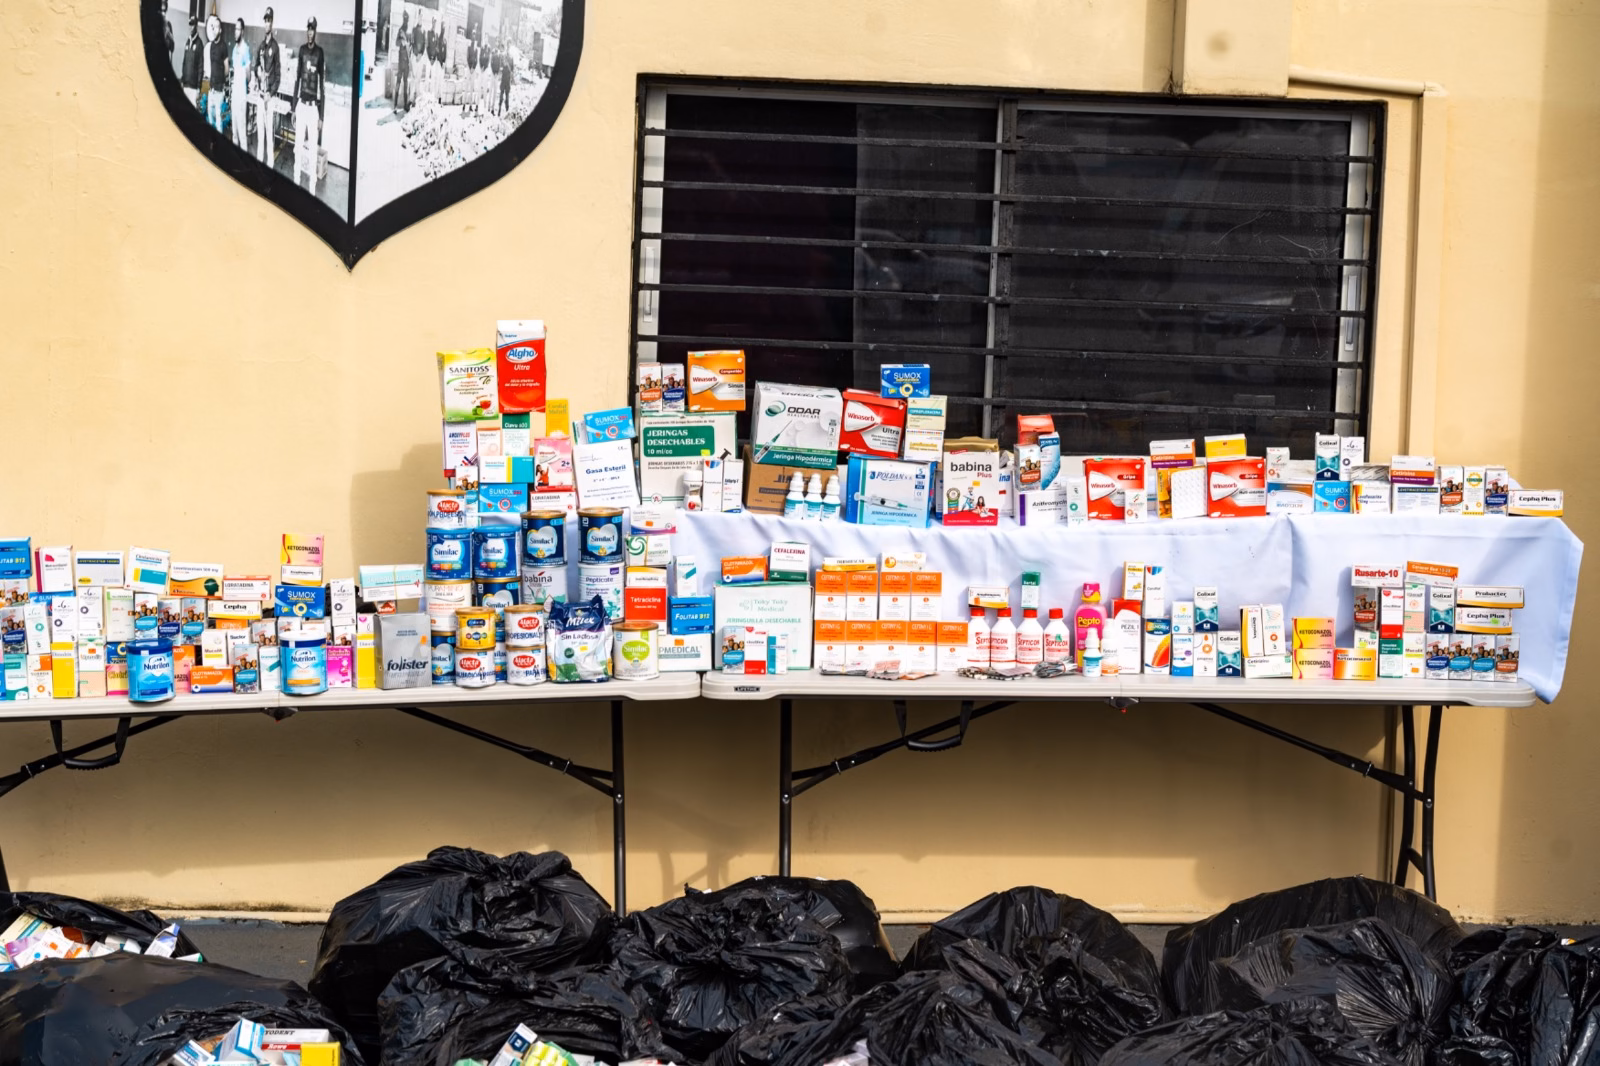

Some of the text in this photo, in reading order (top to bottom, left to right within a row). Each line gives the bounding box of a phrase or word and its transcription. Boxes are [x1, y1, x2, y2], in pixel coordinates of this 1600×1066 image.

[508, 349, 535, 359] Algho
[788, 407, 821, 415] ODAR
[595, 415, 619, 424] SUMOX
[848, 413, 874, 421] Winasorb
[882, 427, 900, 435] Ultra
[647, 438, 706, 446] DESECHABLES
[773, 453, 833, 463] Jeringa Hipodérmica
[951, 462, 992, 471] babina
[434, 548, 458, 556] Similac
[483, 546, 502, 554] Similac
[1355, 569, 1398, 577] Rusarte-10
[524, 574, 552, 583] babina
[1078, 617, 1100, 625] Pepto
[144, 662, 170, 670] Nutrilon
